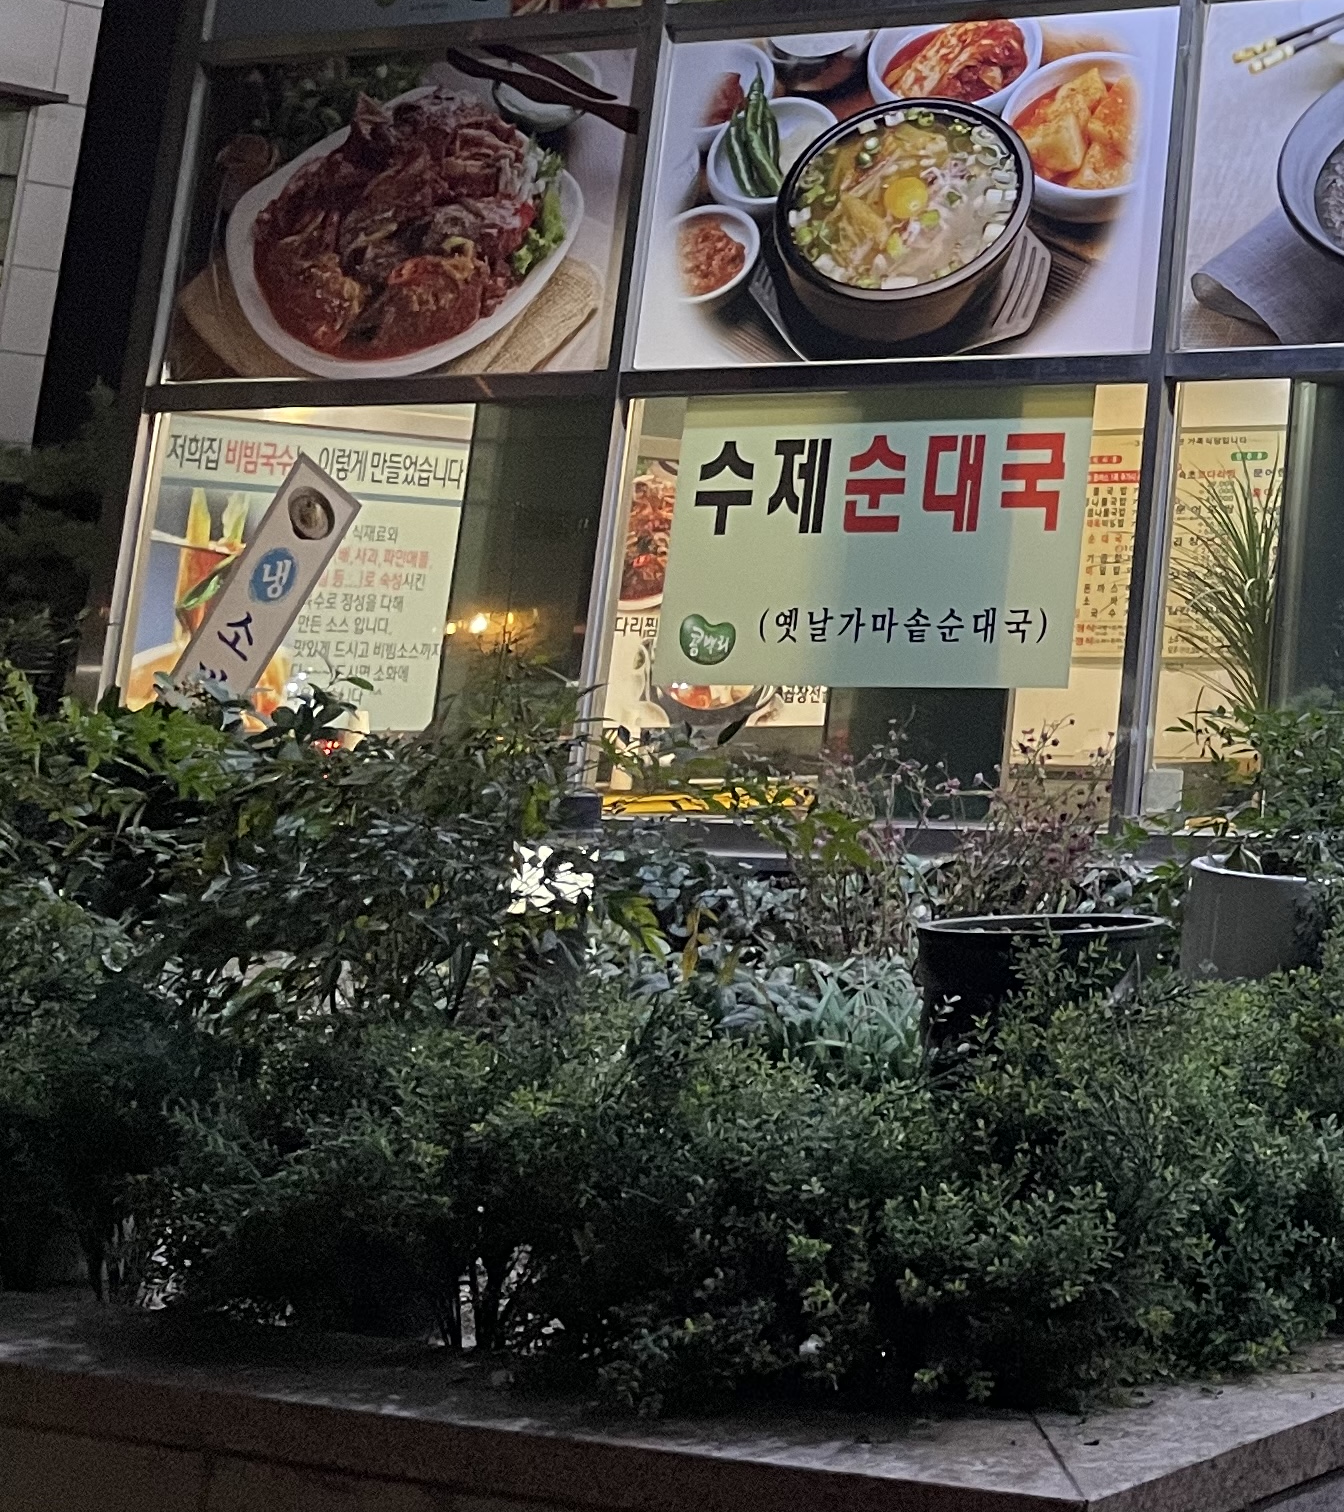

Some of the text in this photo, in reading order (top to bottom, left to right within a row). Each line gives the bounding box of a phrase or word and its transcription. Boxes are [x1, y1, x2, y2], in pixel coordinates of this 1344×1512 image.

[167, 433, 465, 490] 저희집 비빔국수 이렇게 만들었습니다
[694, 431, 1066, 536] 수제순대국
[261, 559, 293, 599] 냉
[757, 605, 1049, 646] (옛날가마솥순대국)
